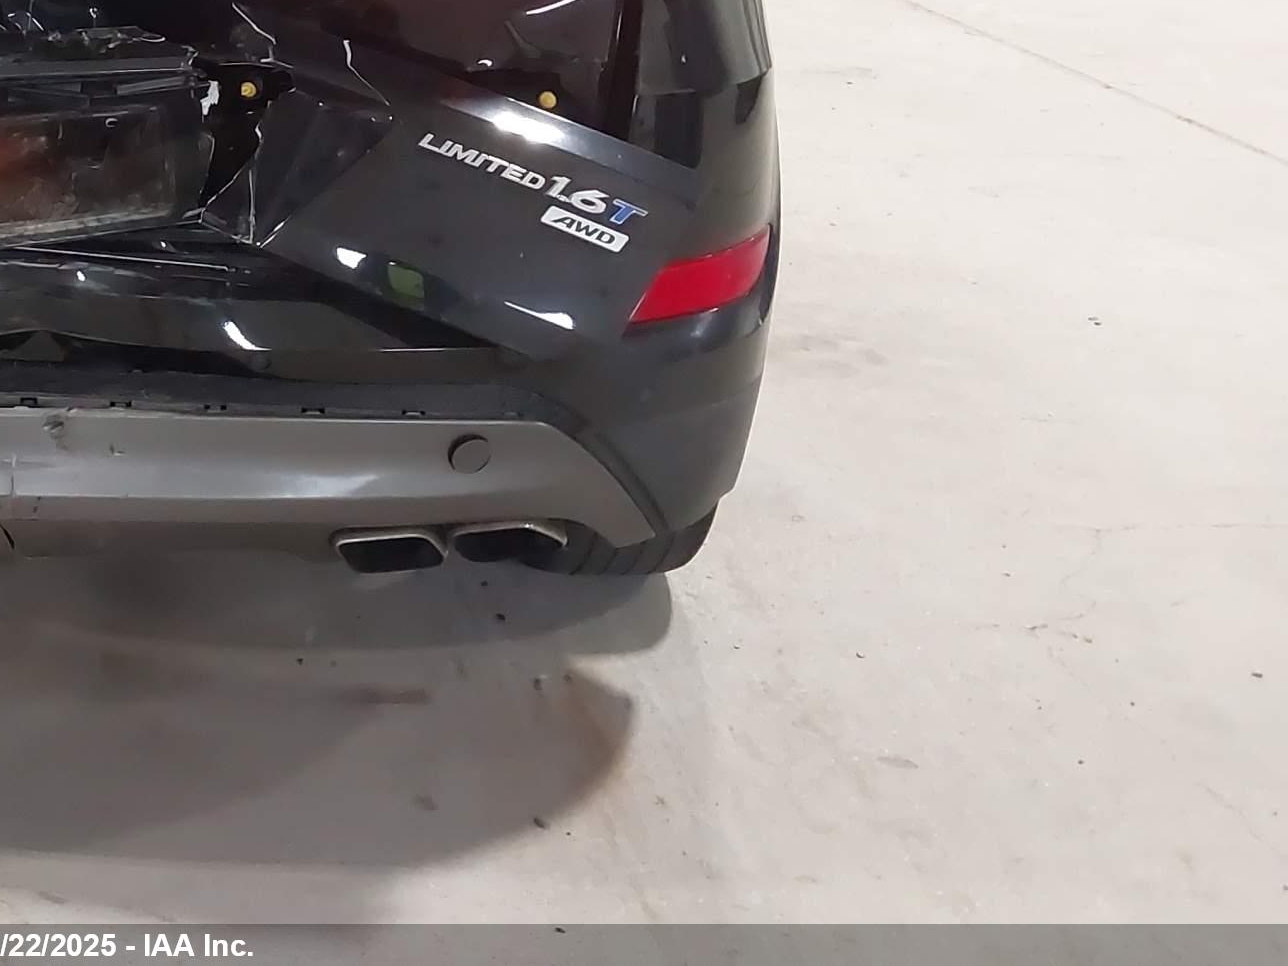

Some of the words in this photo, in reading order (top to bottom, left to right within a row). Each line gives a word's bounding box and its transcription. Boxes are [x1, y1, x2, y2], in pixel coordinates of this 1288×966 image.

[418, 133, 546, 190] LIMITED
[544, 175, 649, 225] 1.6T
[552, 216, 616, 245] AWD
